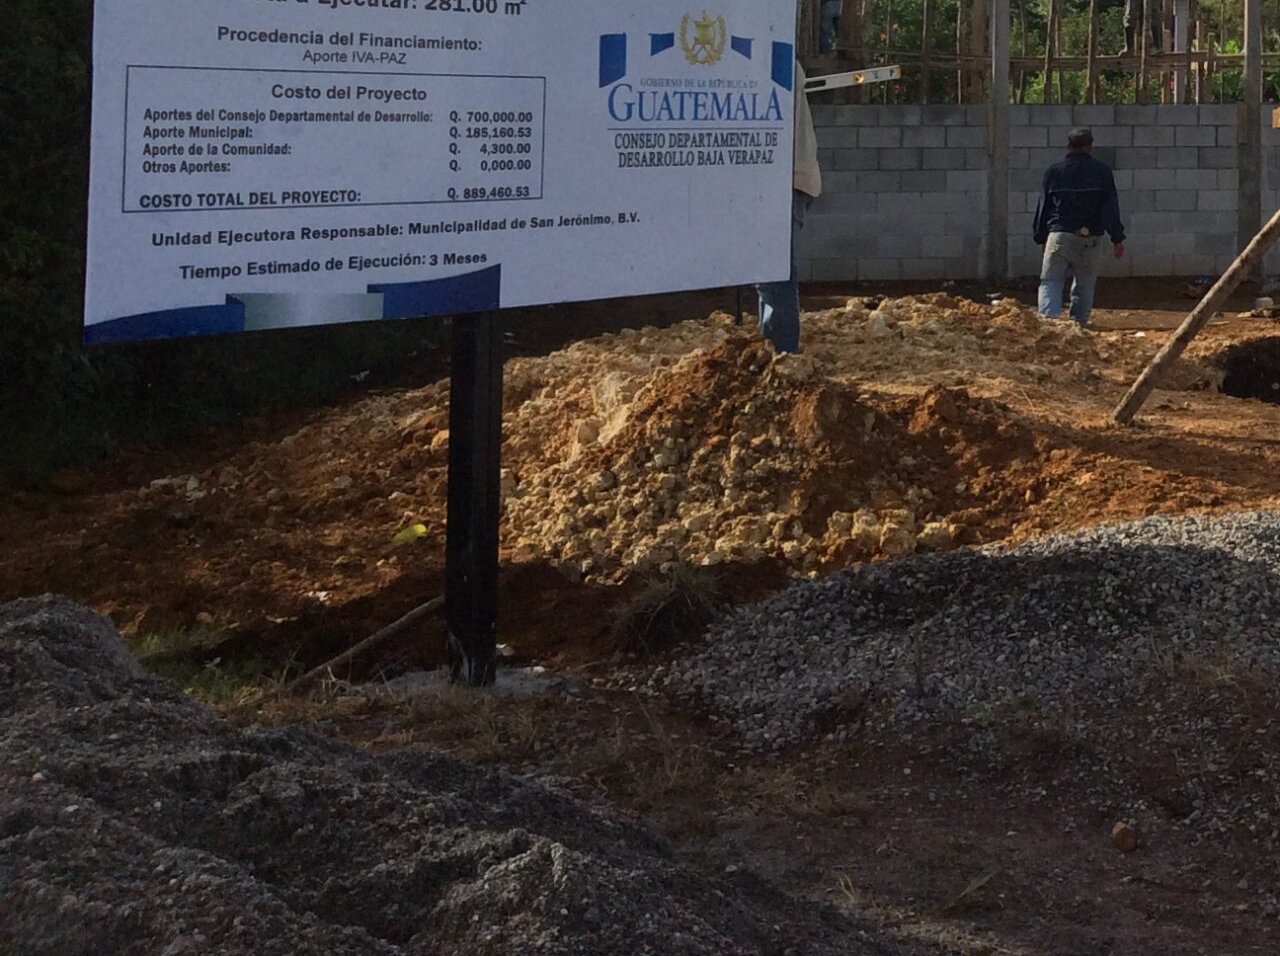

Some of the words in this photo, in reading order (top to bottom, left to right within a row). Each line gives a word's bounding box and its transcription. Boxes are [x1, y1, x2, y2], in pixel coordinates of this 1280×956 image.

[217, 26, 324, 45] Procedencia
[329, 32, 354, 46] del
[359, 33, 482, 52] Financiamiento:
[302, 49, 347, 64] Aporte
[352, 51, 407, 65] IVA-PAZ
[640, 77, 682, 88] GOBIERNO
[684, 78, 694, 88] DE
[697, 78, 707, 88] LA
[271, 84, 321, 99] Costo
[326, 86, 350, 100] del
[356, 86, 427, 104] Proyecto
[608, 83, 784, 122] GUATEMALA
[143, 108, 192, 123] Aportes
[196, 109, 215, 122] del
[218, 109, 266, 124] Consejo
[269, 109, 354, 124] Departamental
[357, 110, 371, 123] de
[374, 111, 433, 123] Desarrollo:
[449, 110, 461, 123] Q.
[466, 112, 533, 124] 700,000.00
[143, 126, 185, 140] Aporte
[189, 125, 253, 140] Municipal:
[449, 126, 461, 139] Q.
[465, 127, 532, 140] 185,160.53
[614, 132, 665, 150] CONSEJO
[669, 131, 761, 149] DEPARTAMENTAL
[765, 131, 778, 147] DE
[143, 143, 185, 158] Aporte
[188, 143, 203, 156] de
[207, 143, 218, 156] la
[222, 143, 292, 156] Comunidad:
[448, 142, 461, 155] Q.
[479, 143, 531, 156] 4,300.00
[449, 159, 461, 172] Q.
[480, 159, 531, 172] 0,000.00
[618, 150, 695, 168] DESARROLLO
[697, 150, 724, 166] BAJA
[728, 149, 773, 165] VERAPAZ
[142, 160, 176, 174] Otros
[180, 160, 231, 175] Aportes:
[139, 194, 192, 209] COSTO
[197, 193, 244, 207] TOTAL
[249, 191, 277, 206] DEL
[281, 189, 361, 205] PROYECTO:
[447, 187, 459, 200] Q.
[463, 186, 530, 201] 889,460.53
[152, 231, 212, 247] Unidad
[218, 228, 296, 246] Ejecutora
[301, 223, 403, 242] Responsable:
[408, 218, 507, 236] Municipalidad
[510, 217, 526, 230] de
[530, 216, 554, 229] San
[557, 213, 615, 228] Jerónimo,
[618, 211, 641, 224] B.V.
[179, 265, 242, 280] Tiempo
[247, 259, 320, 276] Estimado
[325, 257, 343, 272] de
[348, 252, 426, 272] Ejecución:
[429, 254, 438, 267] 3
[443, 252, 488, 265] Meses
